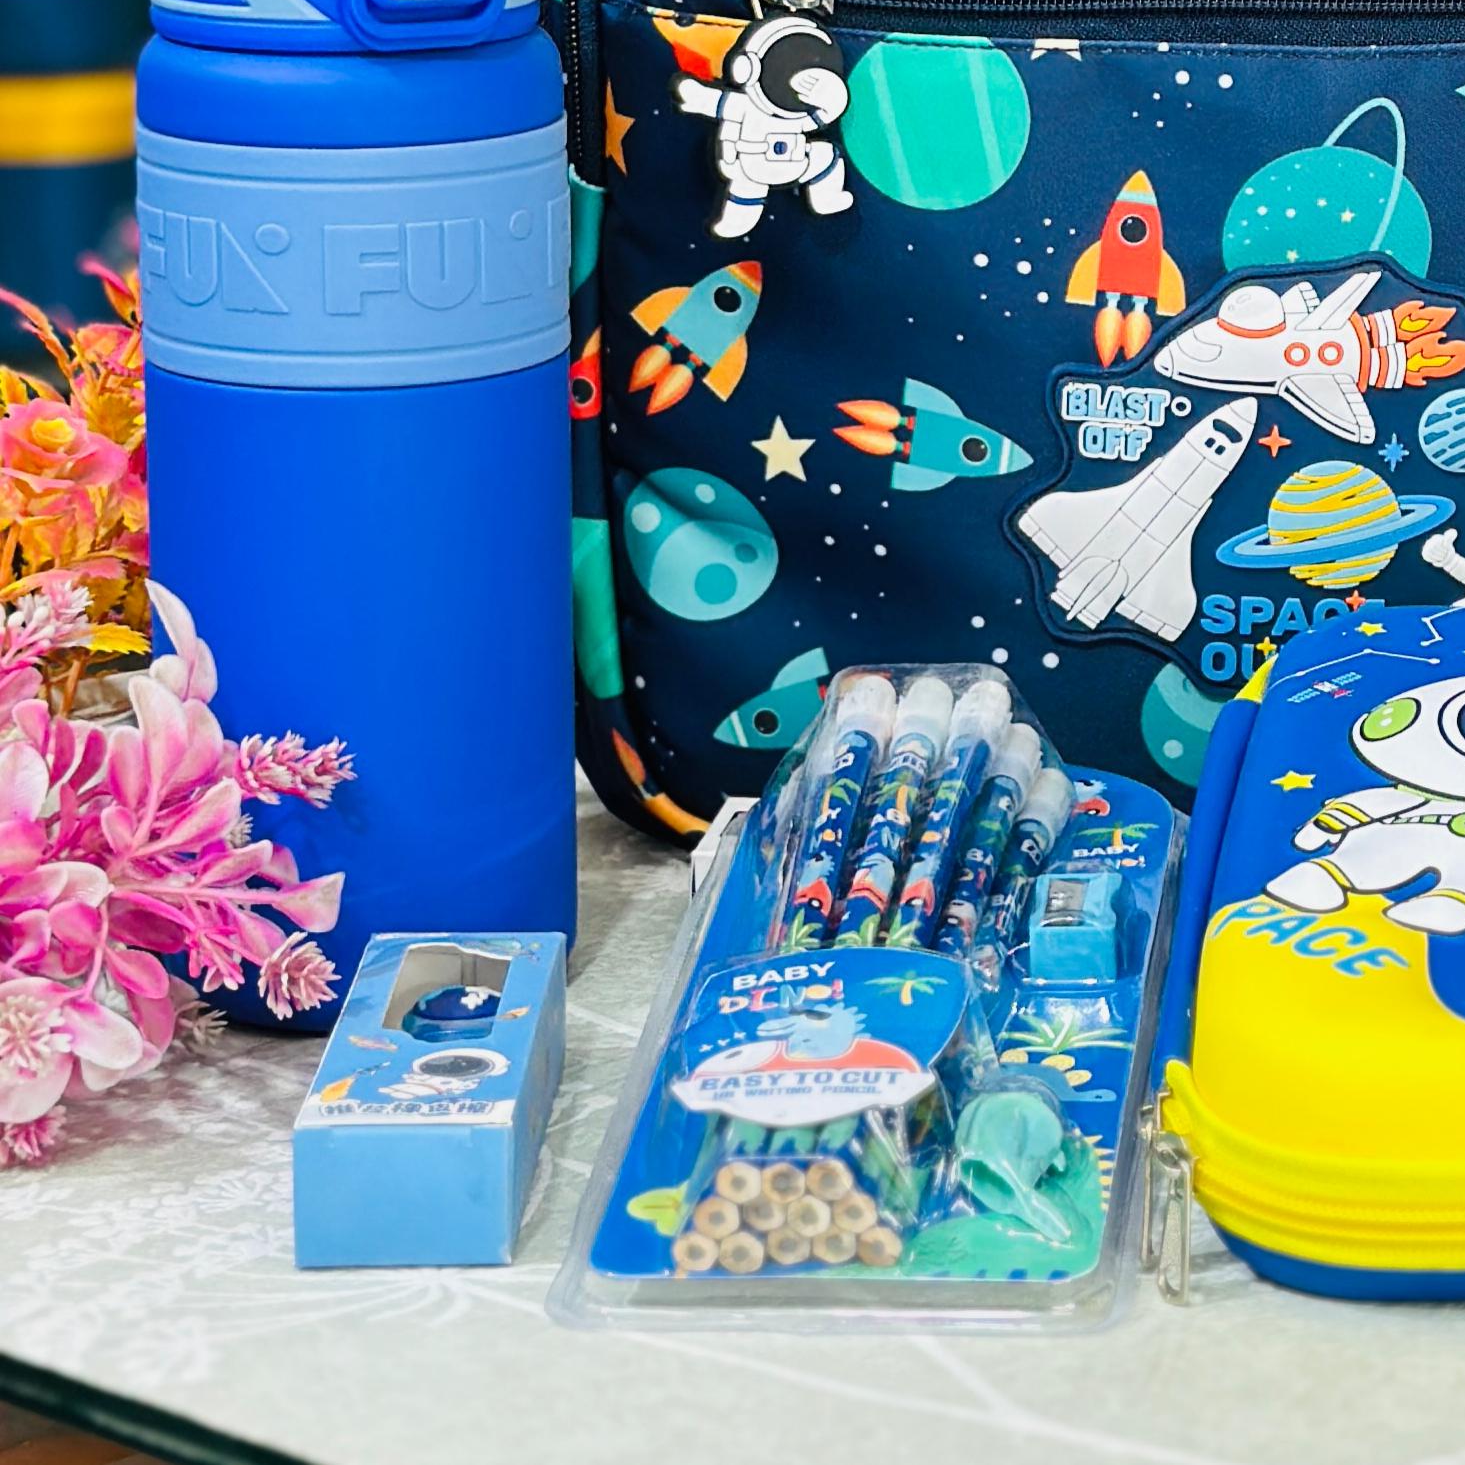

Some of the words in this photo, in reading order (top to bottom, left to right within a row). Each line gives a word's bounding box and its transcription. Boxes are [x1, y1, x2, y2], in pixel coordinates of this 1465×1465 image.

[1062, 383, 1171, 426] BLAST
[1079, 422, 1152, 461] OFF
[732, 961, 836, 991] BABY
[699, 1072, 786, 1091] EASY
[793, 1071, 833, 1084] TO
[840, 1070, 904, 1085] CUT
